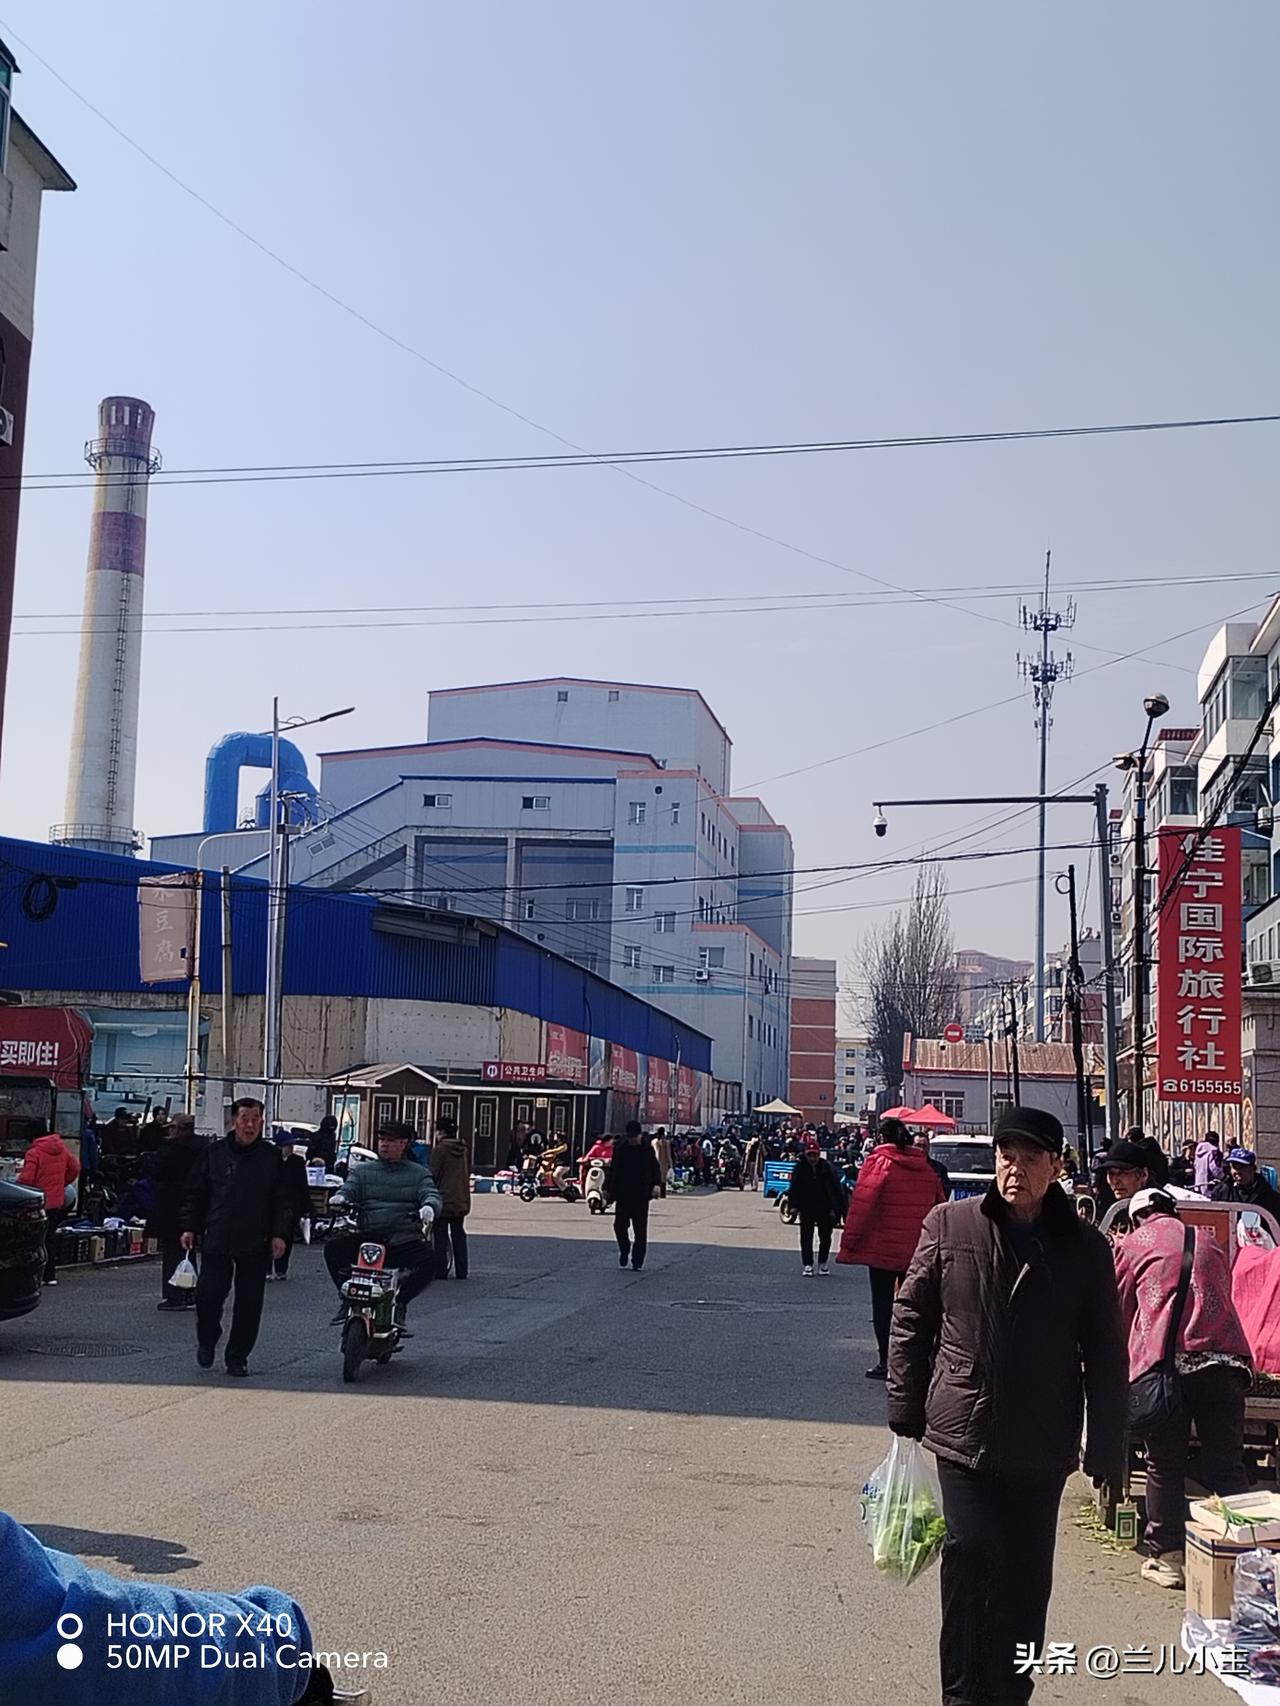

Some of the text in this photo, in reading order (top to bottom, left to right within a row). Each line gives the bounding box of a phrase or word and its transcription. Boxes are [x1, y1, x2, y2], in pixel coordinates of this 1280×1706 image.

[1177, 832, 1227, 1071] 佳宁国际旅行社
[504, 1065, 545, 1077] 公共卫生间
[1180, 1079, 1241, 1094] 6155555
